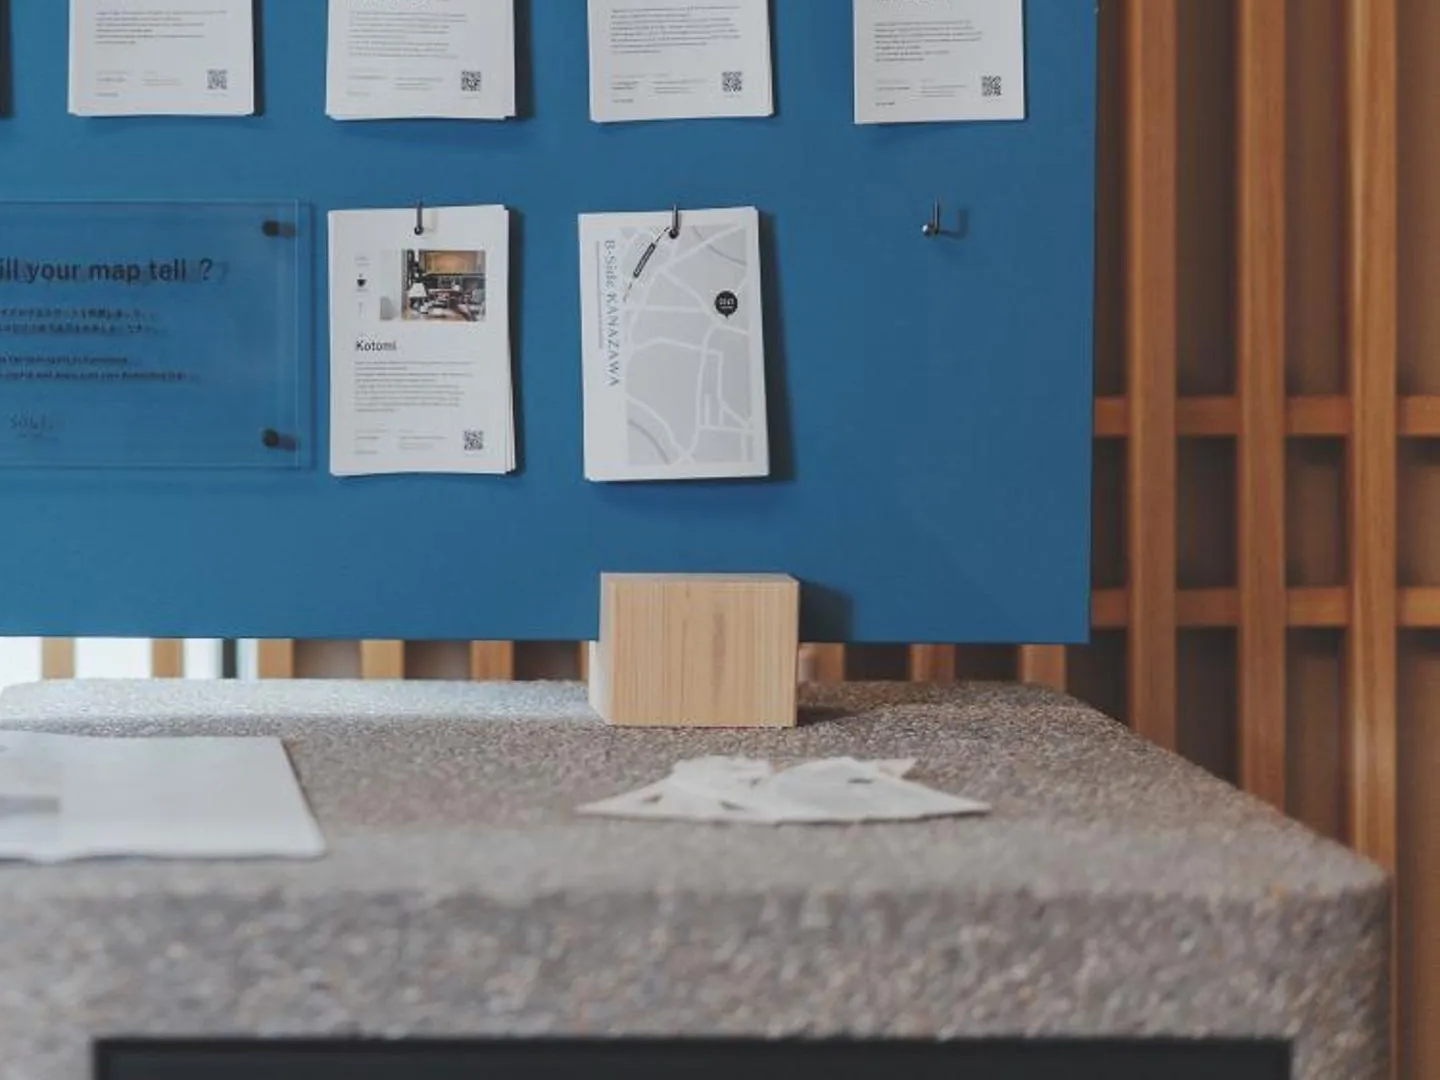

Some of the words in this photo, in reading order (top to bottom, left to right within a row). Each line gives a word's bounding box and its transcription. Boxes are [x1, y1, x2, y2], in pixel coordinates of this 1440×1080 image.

[27, 260, 81, 284] your
[88, 260, 142, 284] map
[149, 257, 186, 281] tell
[198, 257, 213, 281] ?
[605, 239, 618, 288] B-Side
[355, 339, 397, 351] Kotomi
[606, 292, 620, 387] KANAZAWA
